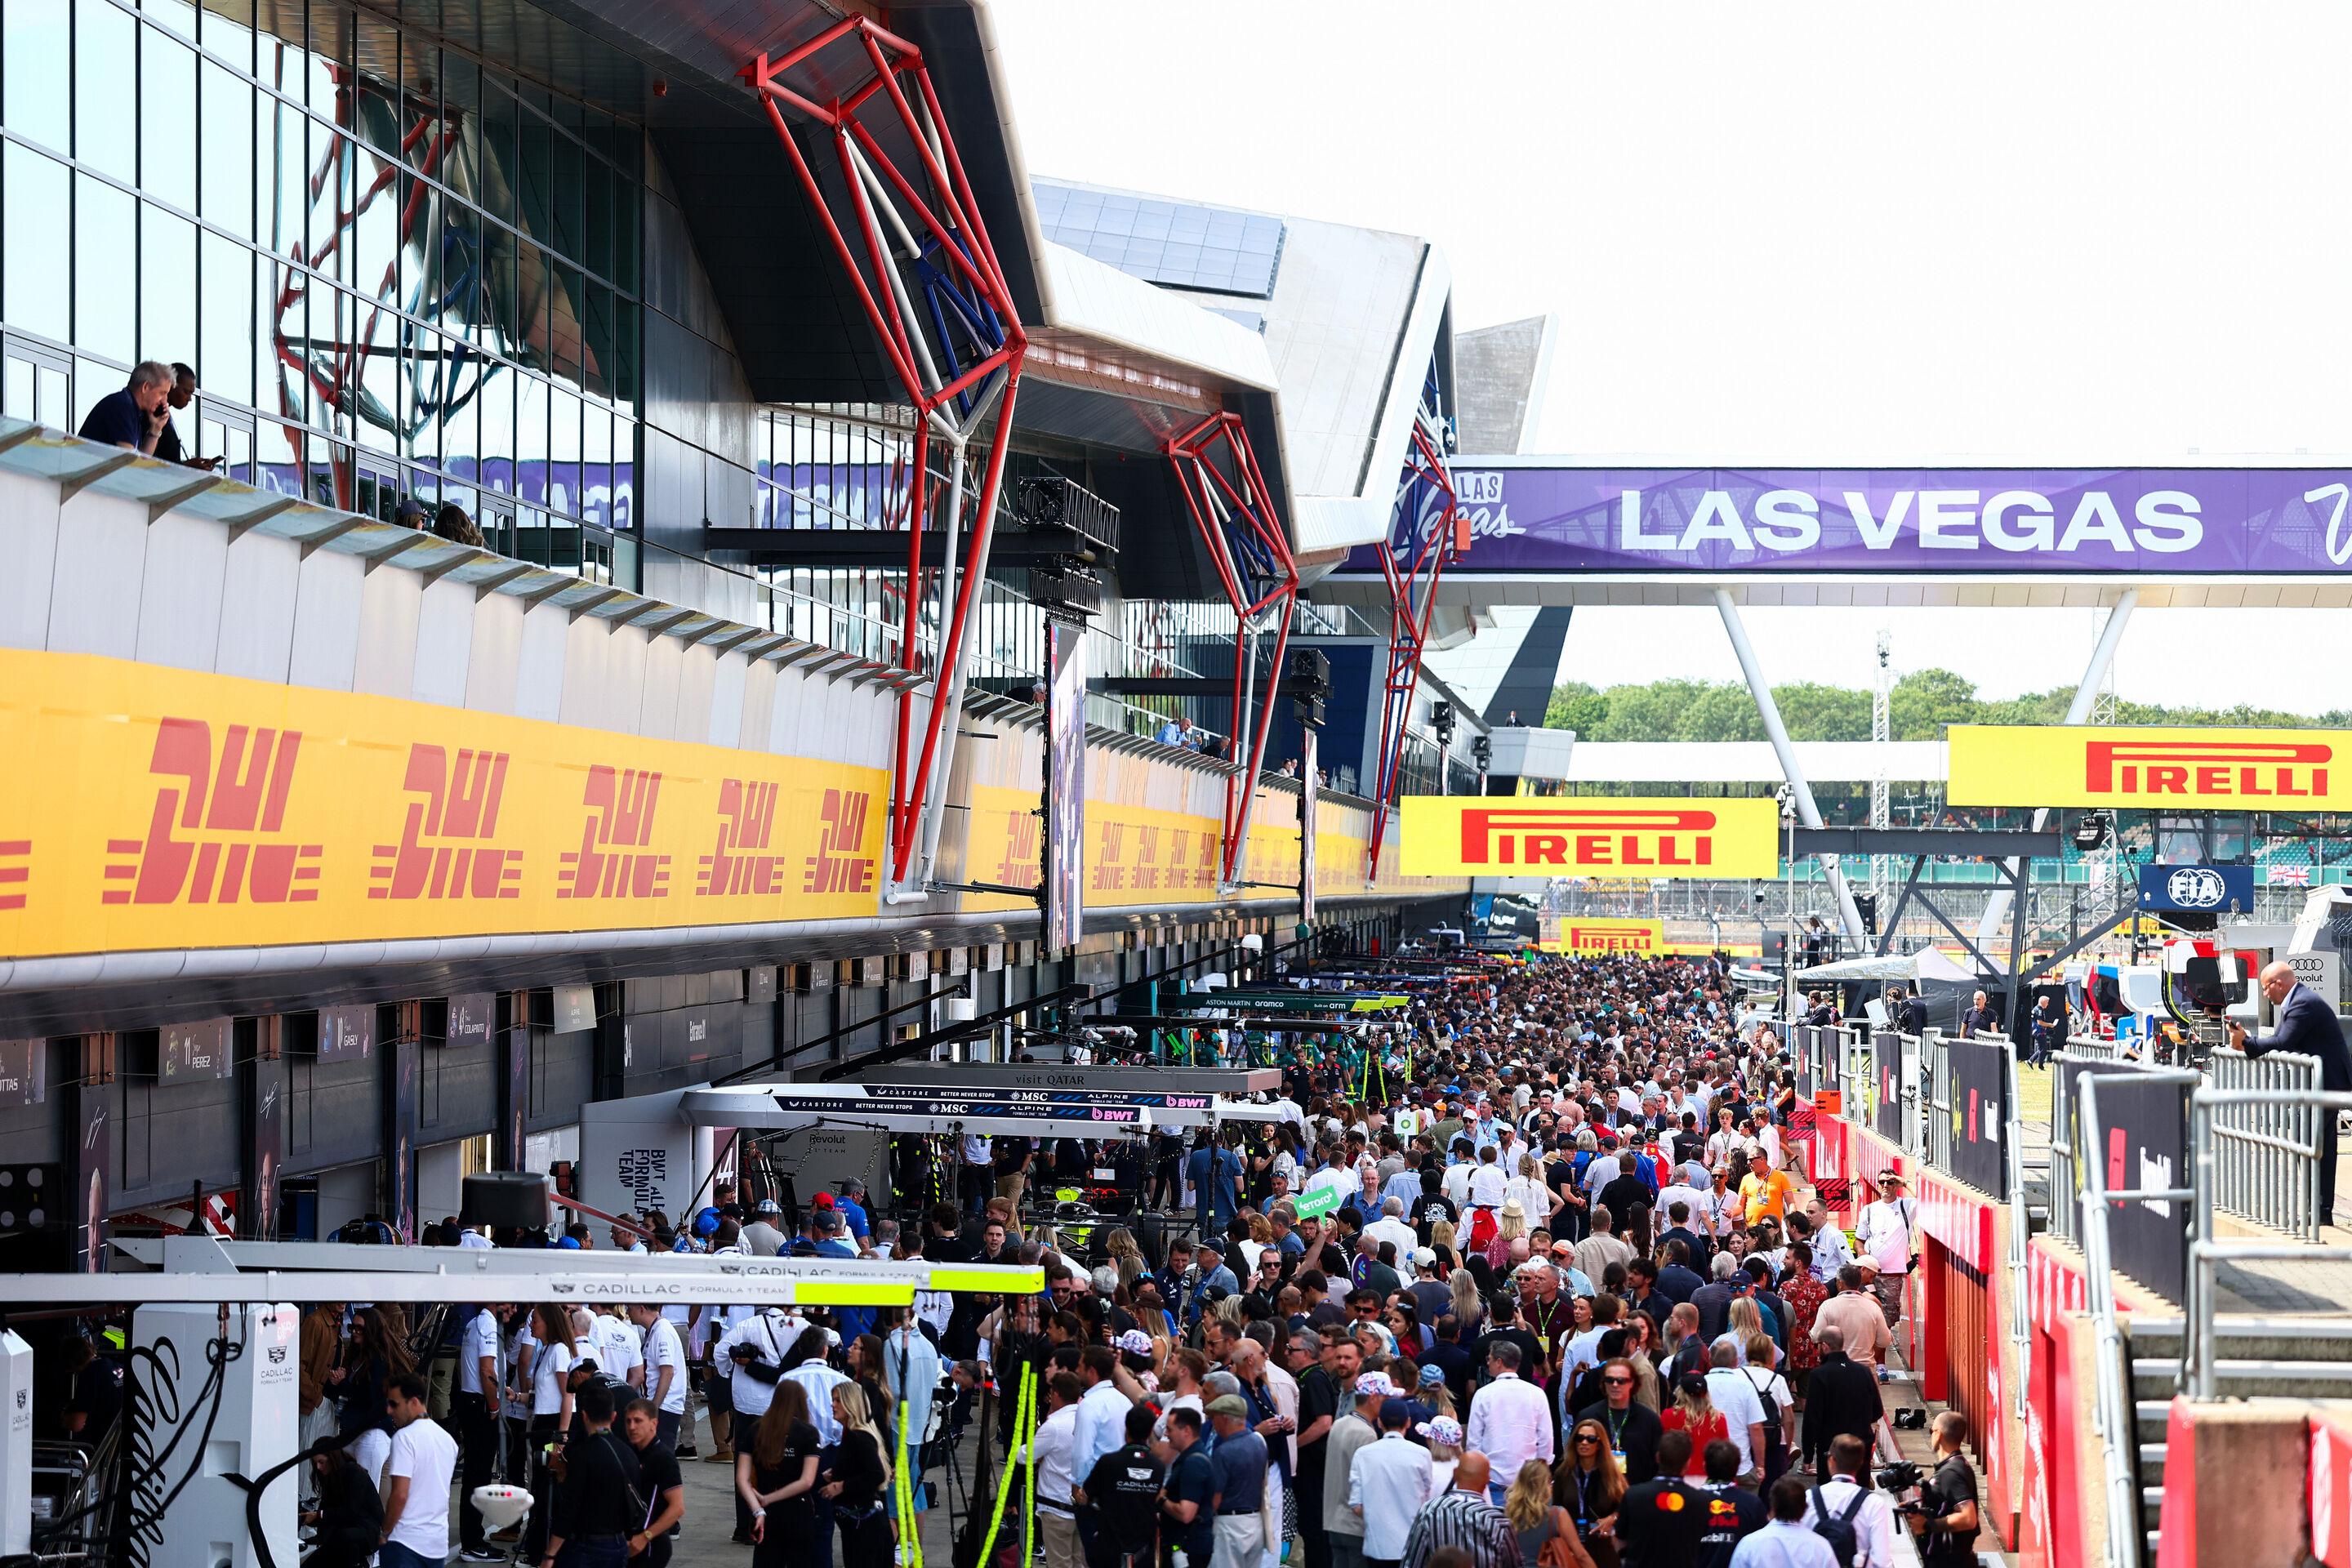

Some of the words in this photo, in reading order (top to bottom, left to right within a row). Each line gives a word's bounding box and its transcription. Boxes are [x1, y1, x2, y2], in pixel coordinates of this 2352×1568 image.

[1460, 476, 1499, 500] LAS
[1621, 489, 1820, 551] LAS
[1842, 490, 2204, 552] VEGAS
[2086, 742, 2332, 797] PIRELLI
[133, 716, 303, 904] DHL
[390, 743, 510, 898] DHL
[573, 764, 662, 898] DHL
[708, 778, 778, 895] DHL
[813, 789, 869, 893] DHL
[1462, 808, 1716, 866] PIRELLI
[1571, 928, 1651, 950] PIRELLI
[2295, 974, 2323, 982] evolut
[344, 1034, 359, 1047] GASLY
[192, 1055, 211, 1069] PEREZ
[1016, 1076, 1042, 1085] visit
[1047, 1076, 1085, 1085] QATAR
[940, 1104, 969, 1114] MSC
[1104, 1111, 1134, 1121] BWT
[1022, 1092, 1049, 1102] MSC
[1178, 1098, 1206, 1108] BWT
[809, 1134, 846, 1144] Revolut
[619, 1150, 635, 1188] TEAM
[651, 1150, 666, 1182] BWT
[635, 1150, 650, 1214] FORMULA
[584, 1284, 681, 1294] CADILLAC
[261, 1367, 293, 1378] CADILLAC
